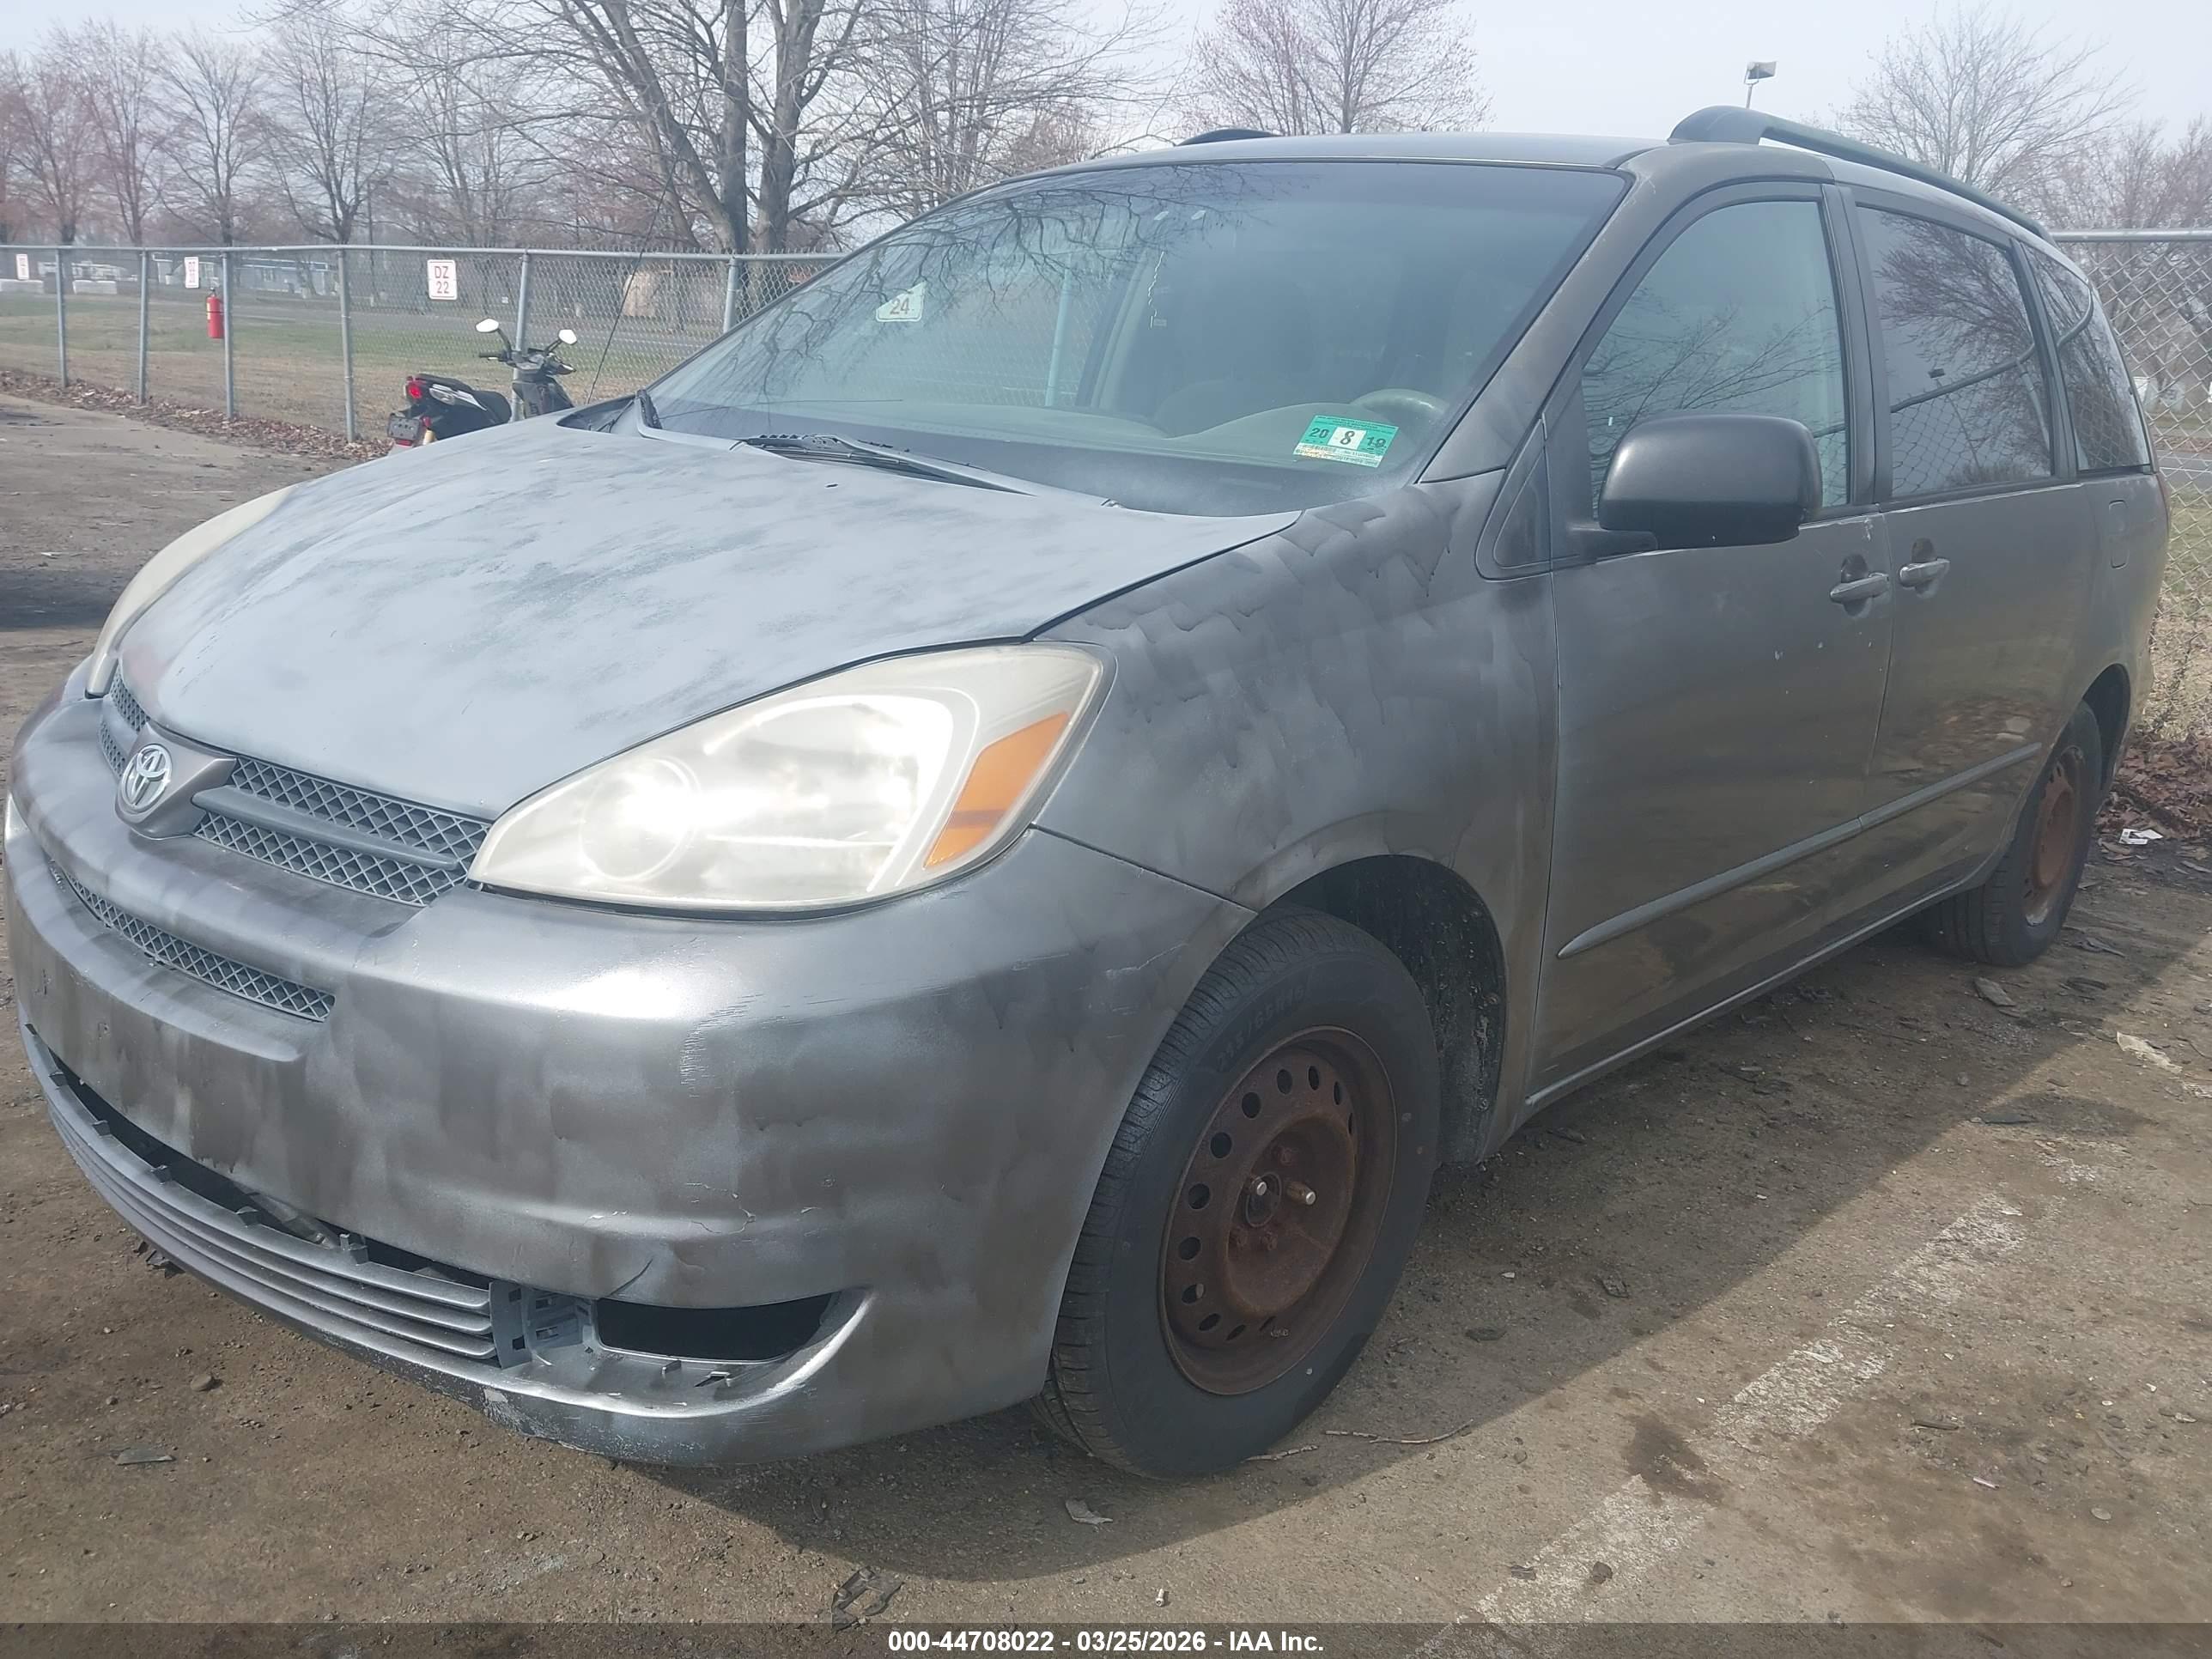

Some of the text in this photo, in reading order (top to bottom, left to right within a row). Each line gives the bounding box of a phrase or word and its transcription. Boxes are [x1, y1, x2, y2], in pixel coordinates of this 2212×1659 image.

[434, 265, 449, 279] DZ
[435, 281, 449, 294] 22
[890, 297, 910, 315] 24
[1309, 428, 1329, 439] 20
[1340, 430, 1355, 446] 8
